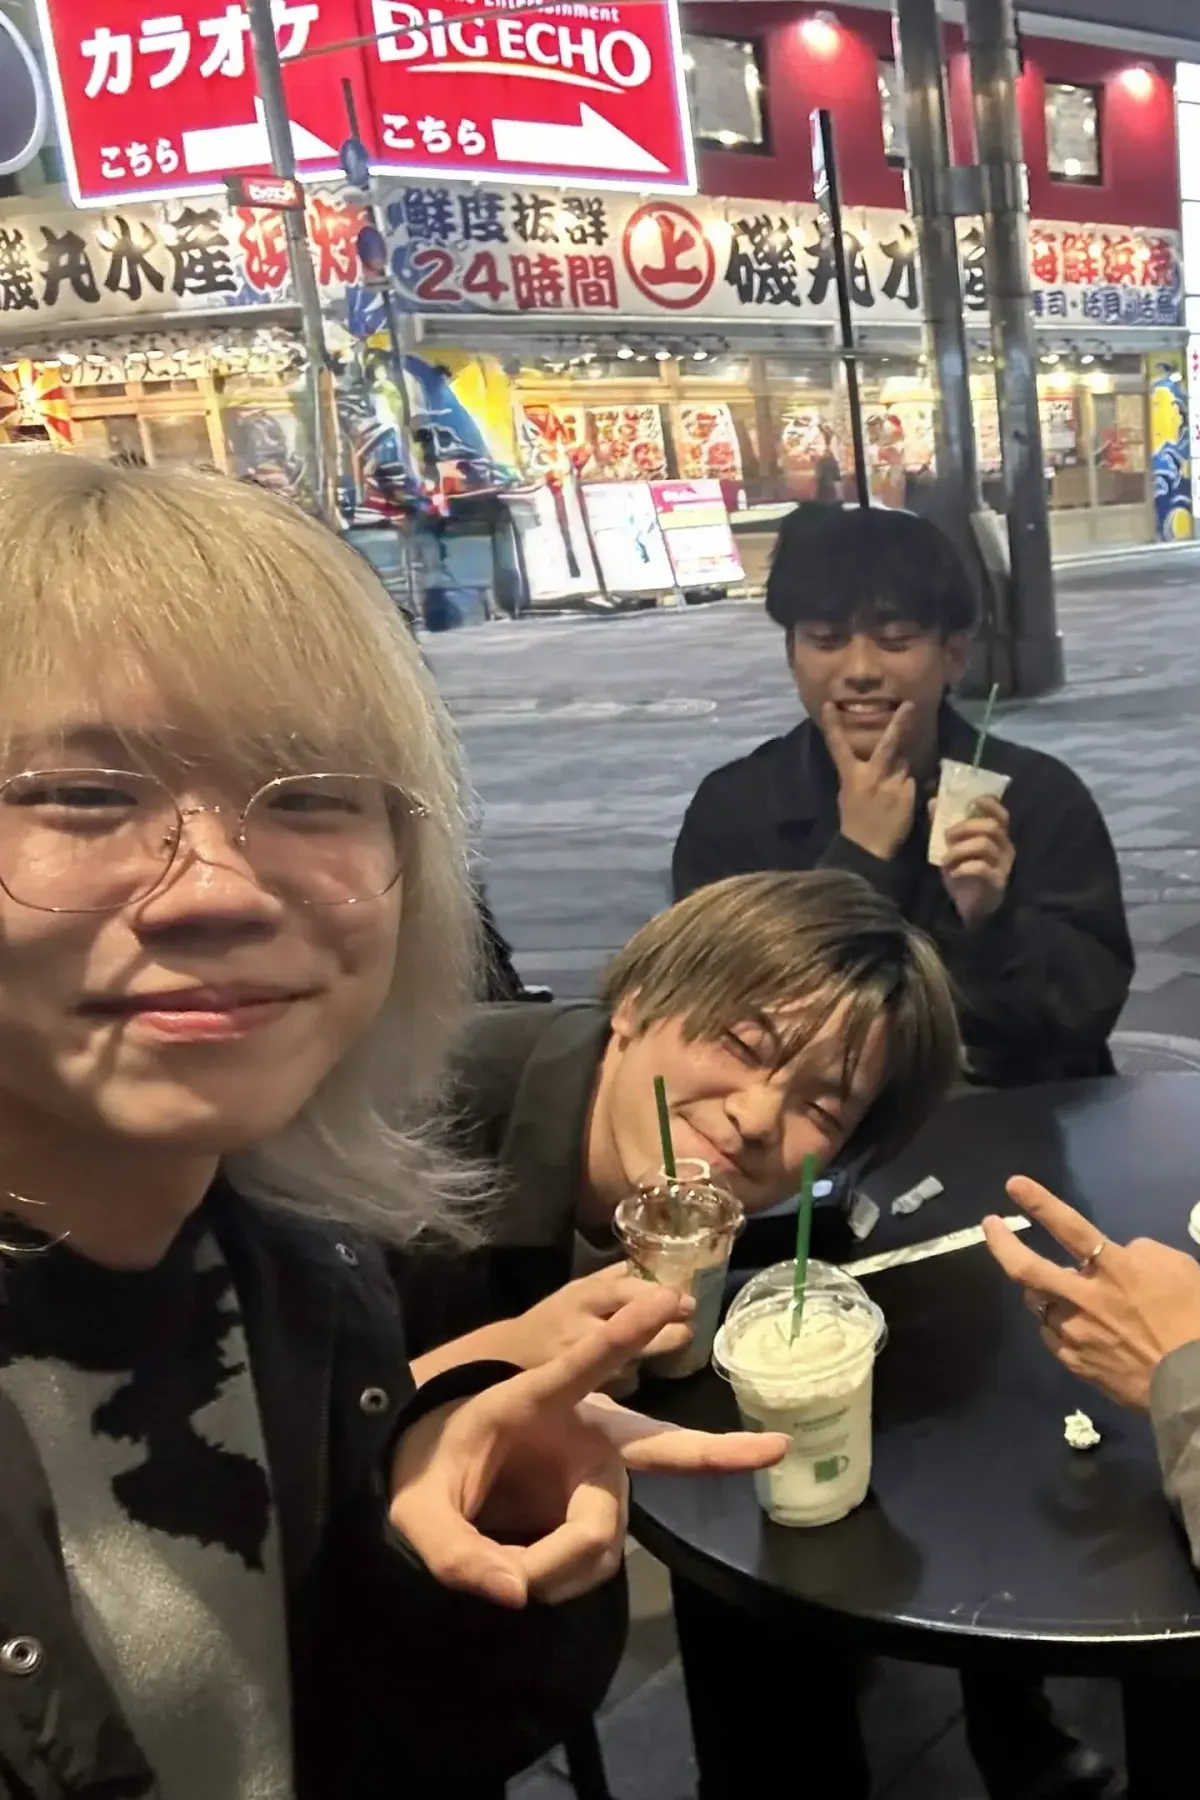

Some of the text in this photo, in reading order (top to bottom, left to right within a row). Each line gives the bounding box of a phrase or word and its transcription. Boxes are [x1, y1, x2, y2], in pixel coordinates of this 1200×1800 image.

[80, 0, 320, 99] カラオケ
[372, 0, 652, 88] BIG ECHO
[100, 138, 179, 179] こちら
[382, 113, 487, 156] こちら
[402, 187, 609, 246] 鮮度抜群
[413, 249, 619, 310] 24時間
